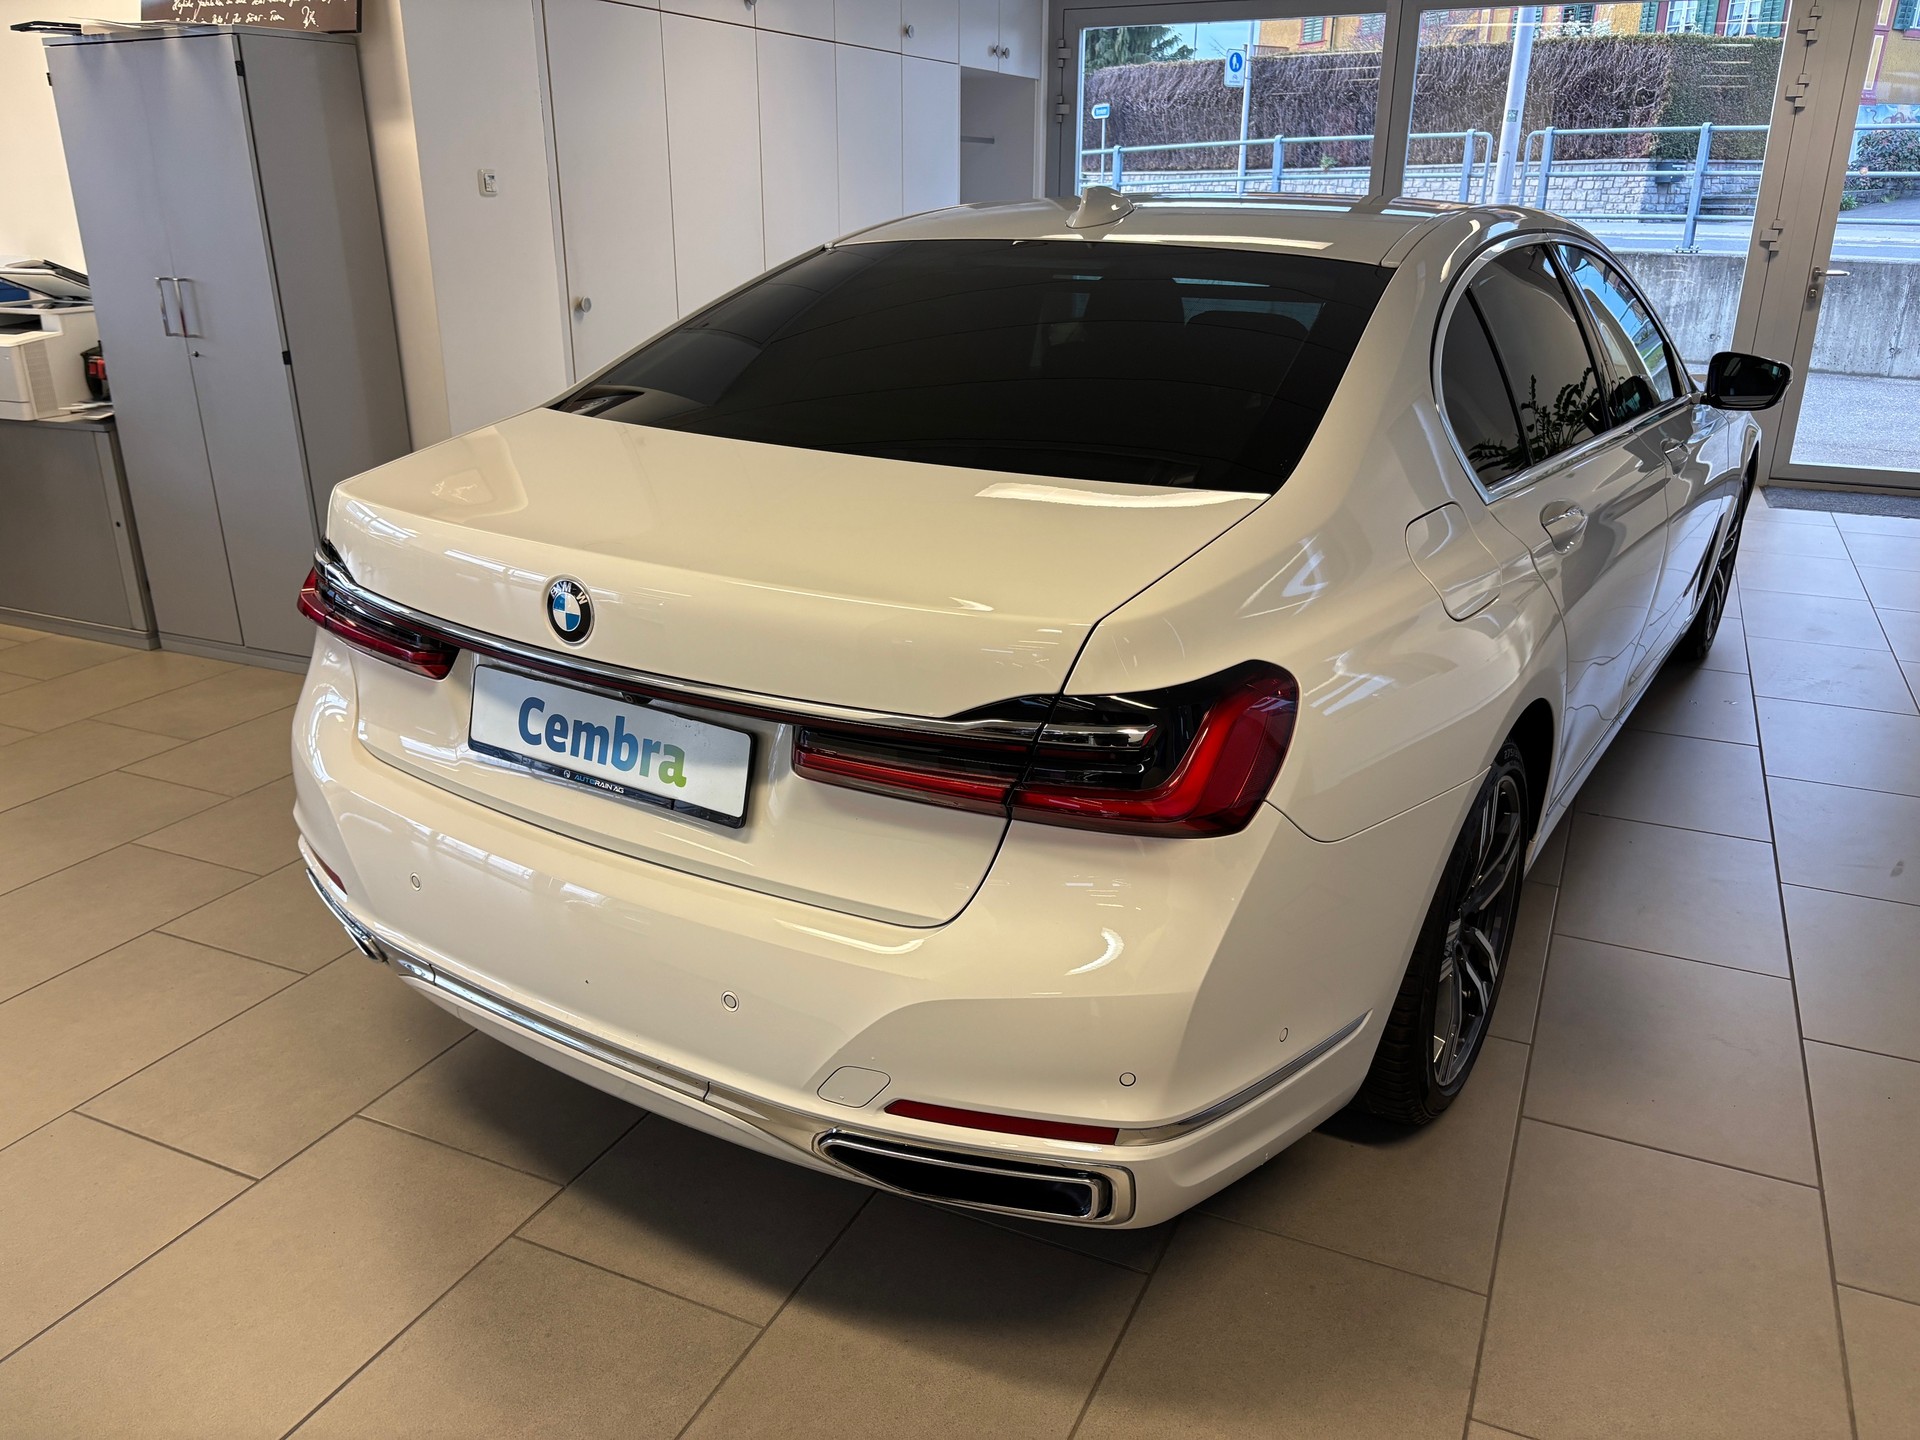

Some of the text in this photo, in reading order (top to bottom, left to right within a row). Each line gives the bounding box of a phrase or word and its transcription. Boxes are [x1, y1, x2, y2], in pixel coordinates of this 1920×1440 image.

[550, 581, 588, 605] BMW
[518, 696, 687, 788] Cembra
[574, 774, 625, 794] AUTORAIN AG
